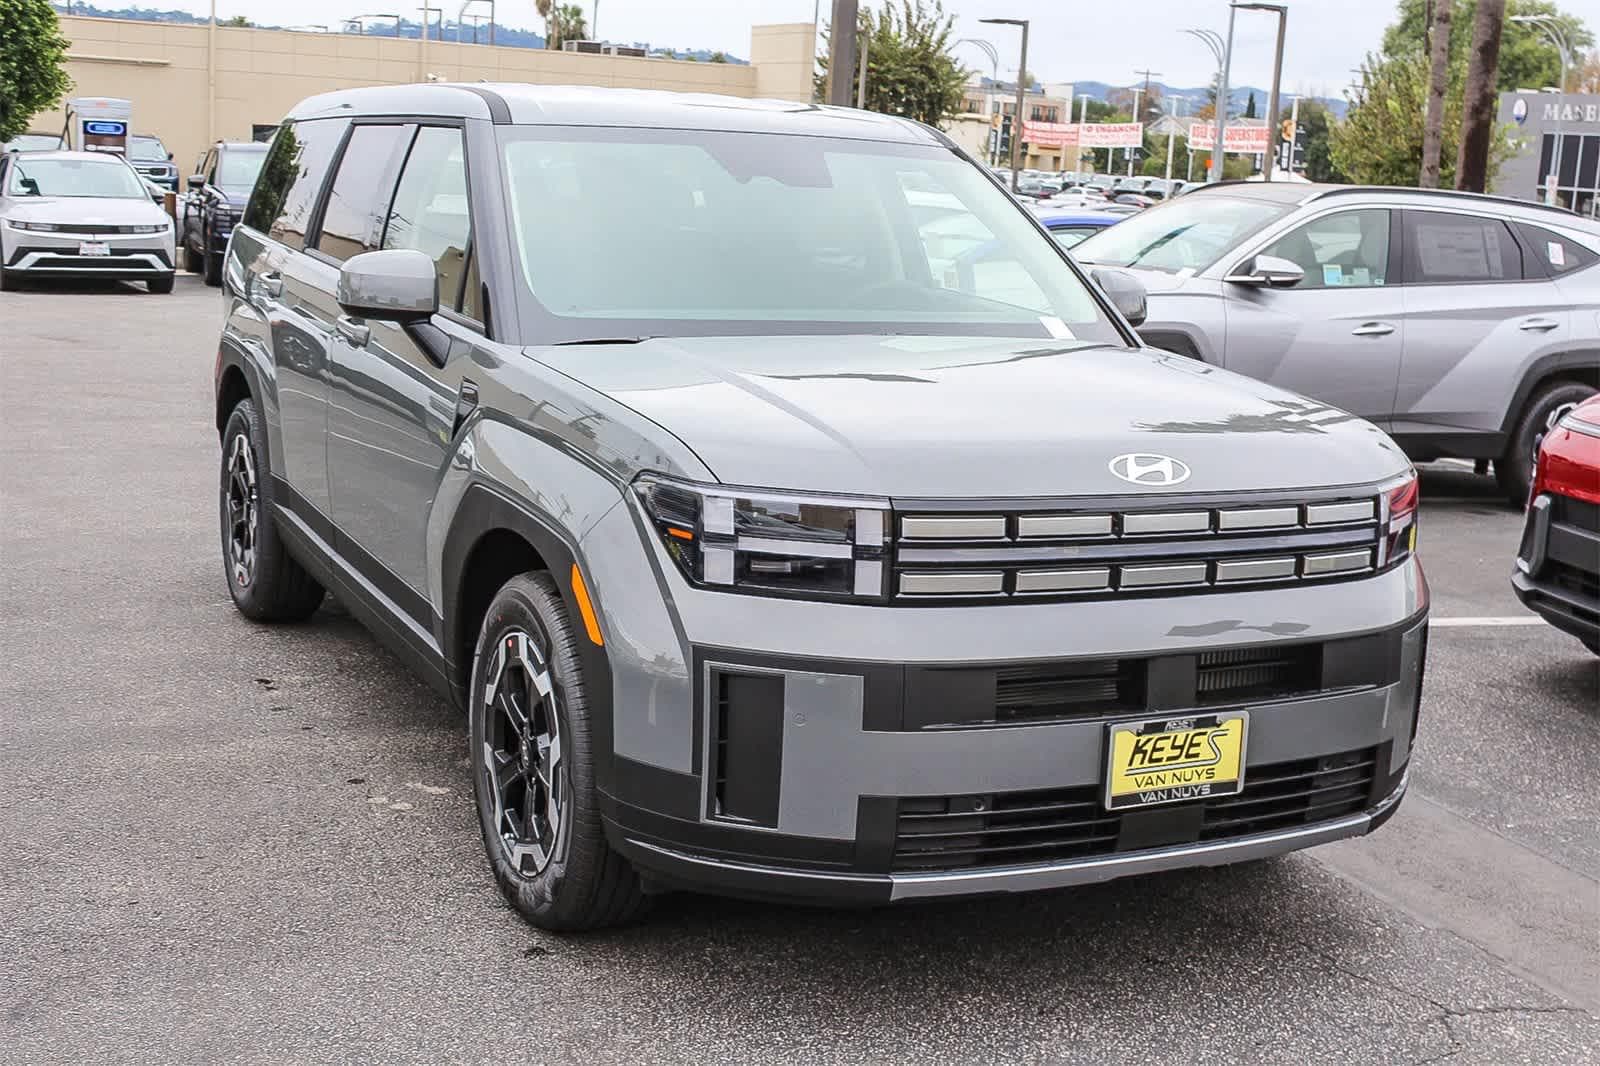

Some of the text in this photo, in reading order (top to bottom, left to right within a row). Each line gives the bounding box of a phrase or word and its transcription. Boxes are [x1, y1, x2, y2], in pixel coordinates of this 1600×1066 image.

[1543, 103, 1600, 121] MASE
[1126, 729, 1229, 773] KEYES
[1135, 768, 1216, 788] VAN NUYS
[1139, 784, 1211, 803] VAN NUYS
